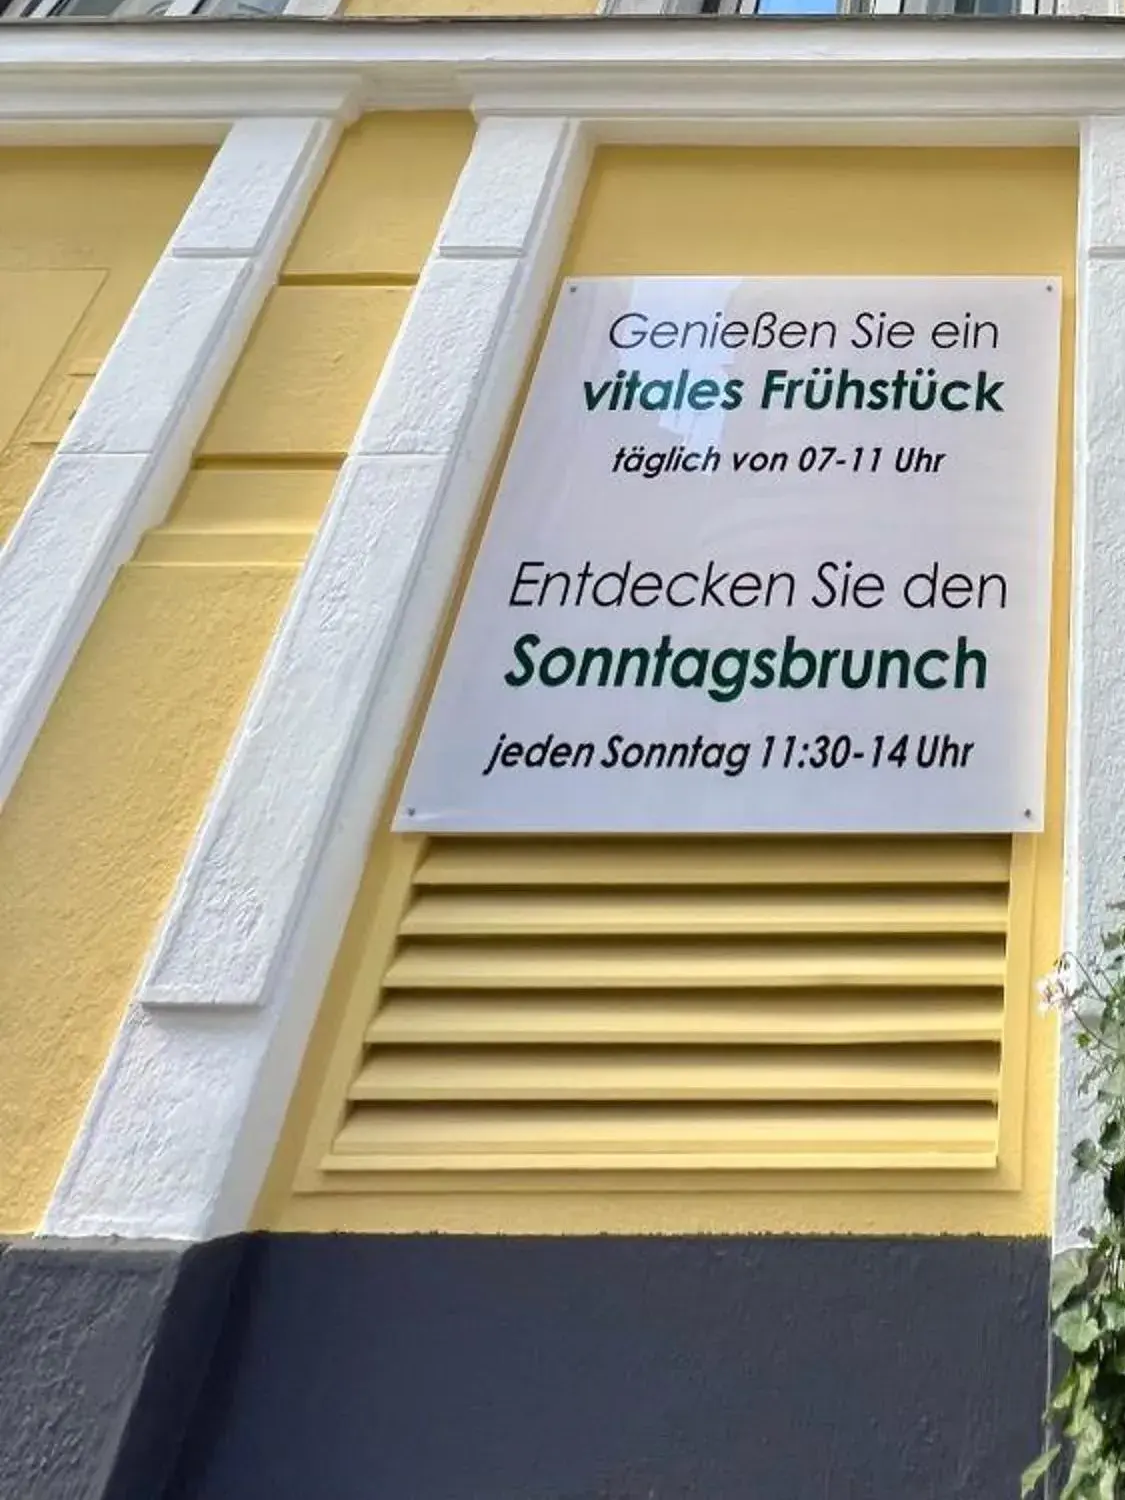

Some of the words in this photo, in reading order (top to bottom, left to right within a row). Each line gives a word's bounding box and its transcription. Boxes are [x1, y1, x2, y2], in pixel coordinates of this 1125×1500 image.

[608, 311, 837, 350] Genießen
[850, 311, 916, 351] Sie
[930, 311, 1000, 350] ein
[583, 367, 745, 412] vitales
[760, 366, 1006, 413] Frühstück
[611, 445, 722, 480] täglich
[732, 451, 790, 474] von
[797, 445, 883, 473] 07-11
[894, 445, 948, 474] Uhr
[508, 559, 796, 609] Entdecken
[810, 559, 886, 610] Sie
[903, 560, 1007, 610] den
[503, 633, 988, 704] Sonntagsbrunch
[481, 732, 596, 777] jeden
[599, 733, 752, 778] Sonntag
[761, 733, 910, 770] 11:30-14
[915, 733, 976, 770] Uhr
